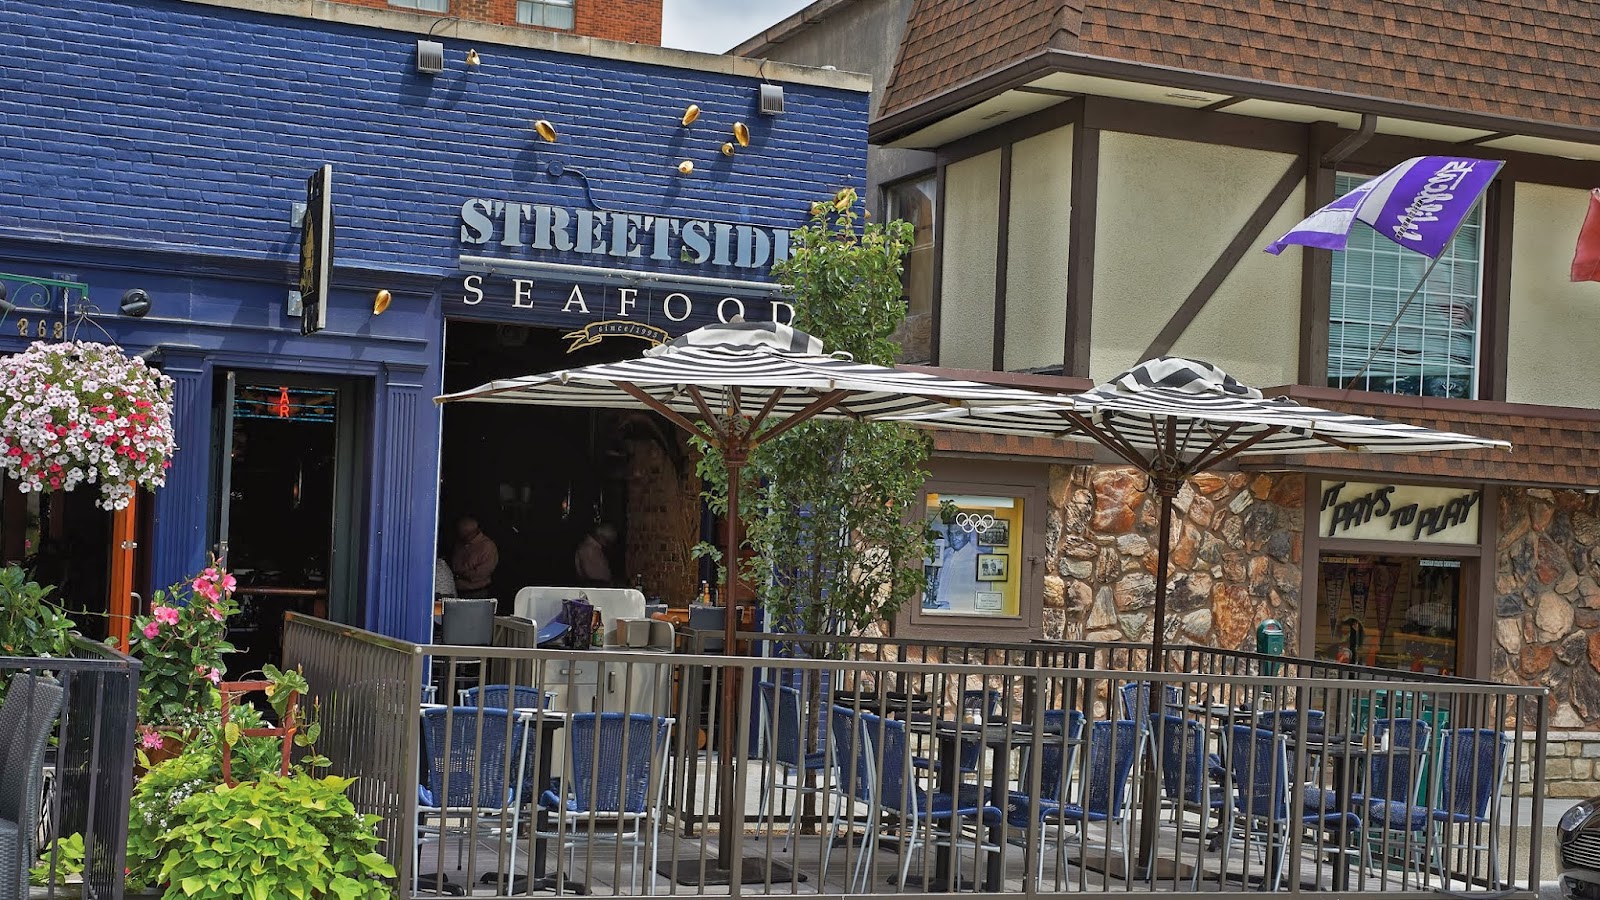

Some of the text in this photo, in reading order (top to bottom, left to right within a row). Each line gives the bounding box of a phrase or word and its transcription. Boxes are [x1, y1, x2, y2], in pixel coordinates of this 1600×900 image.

[463, 275, 796, 327] SEAFOOD
[1320, 482, 1480, 540] IT PAYS TO PLAY
